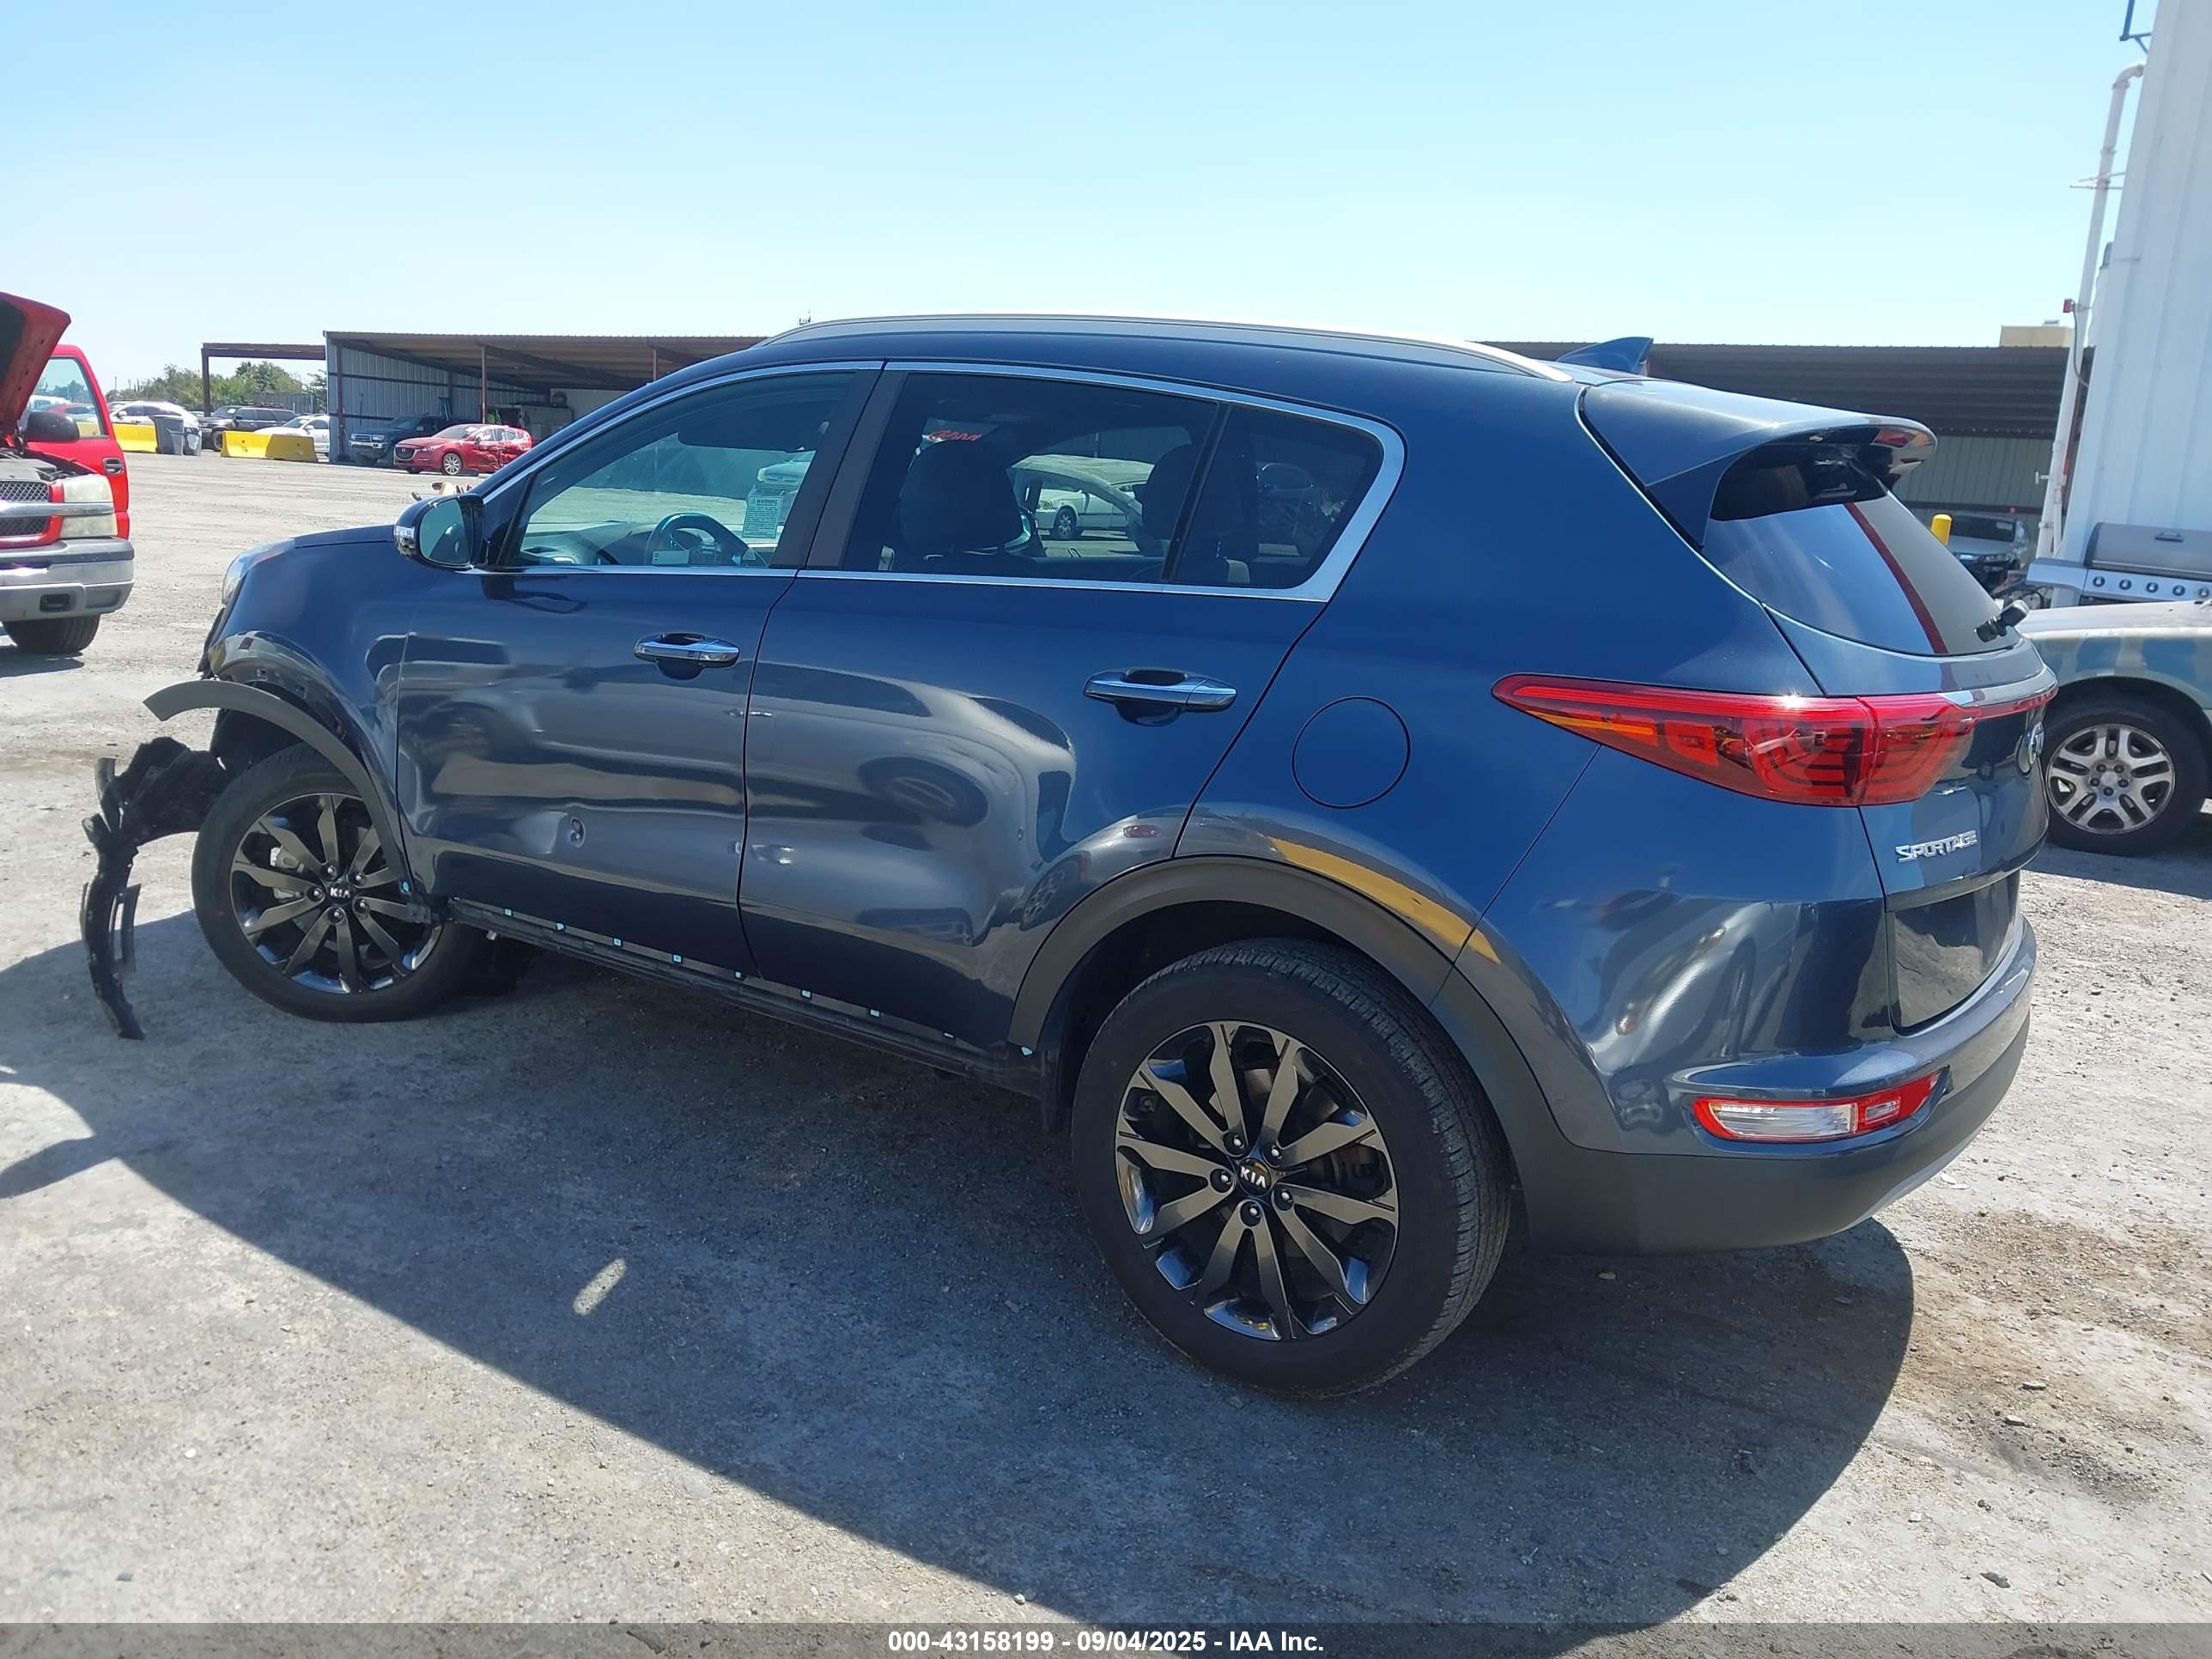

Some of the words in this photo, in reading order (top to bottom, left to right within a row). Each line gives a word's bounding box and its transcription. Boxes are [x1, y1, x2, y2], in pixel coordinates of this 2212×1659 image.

[1895, 830, 1978, 863] SPORTAGE
[330, 887, 350, 898] KIA
[1240, 1165, 1267, 1189] KIA
